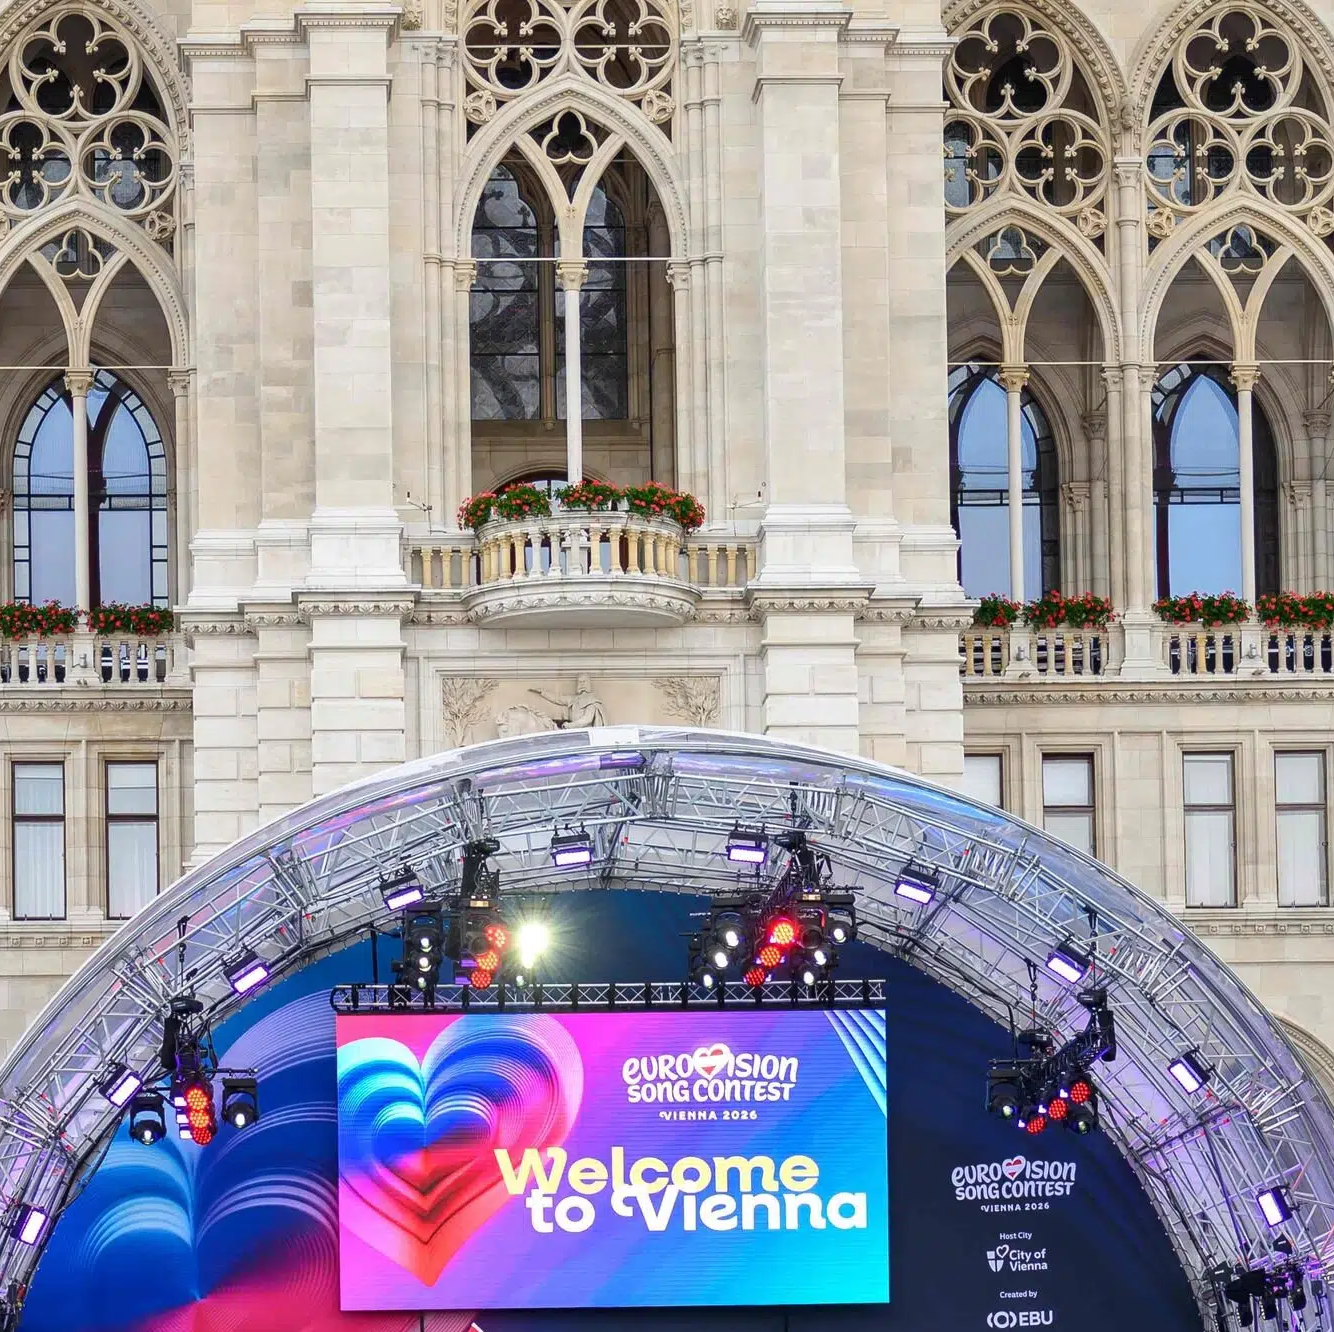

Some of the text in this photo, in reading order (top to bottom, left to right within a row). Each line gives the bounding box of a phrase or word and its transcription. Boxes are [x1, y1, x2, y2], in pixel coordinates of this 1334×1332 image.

[659, 1110, 758, 1121] VIENNA 2026
[495, 1147, 819, 1195] Welcome
[526, 1181, 867, 1233] to Vienna
[980, 1202, 1050, 1212] VIENNA 2026
[999, 1231, 1032, 1240] Host City
[1009, 1248, 1046, 1262] City of
[1009, 1261, 1048, 1271] Vienna
[999, 1290, 1037, 1298] Created by
[1019, 1310, 1053, 1326] EBU
